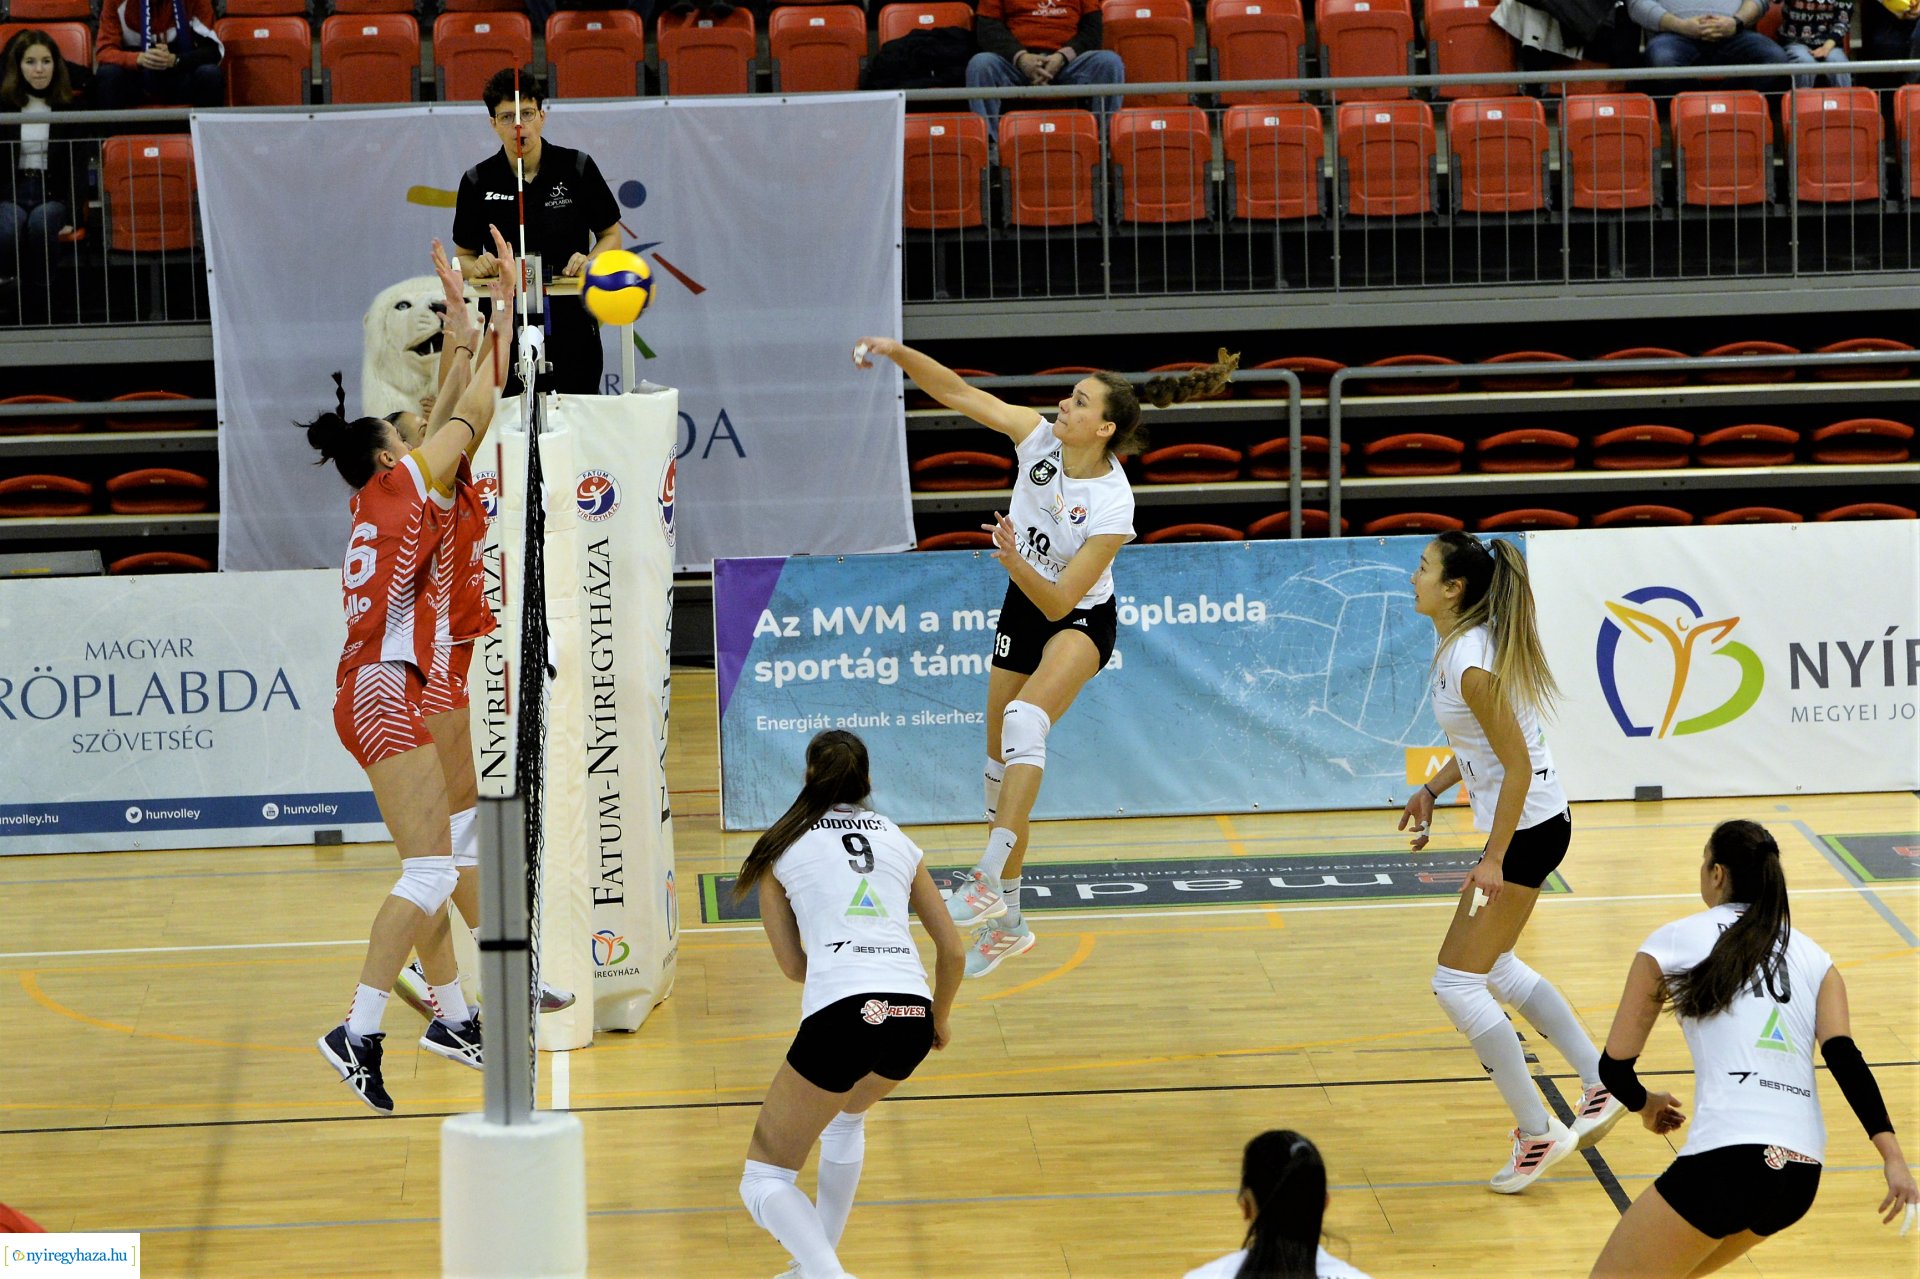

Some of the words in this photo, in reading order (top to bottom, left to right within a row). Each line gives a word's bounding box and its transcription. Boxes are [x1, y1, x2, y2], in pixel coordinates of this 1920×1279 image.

[484, 191, 515, 201] Zeus
[476, 471, 496, 480] FATU
[582, 471, 609, 480] FATUM
[343, 523, 378, 589] 6
[753, 609, 801, 639] Az
[812, 604, 906, 636] MVM
[919, 611, 940, 633] a
[952, 608, 1001, 632] ma
[1117, 593, 1267, 632] öplabda
[85, 638, 195, 662] MAGYAR
[754, 647, 899, 689] sportág
[756, 713, 831, 733] Energiát
[836, 711, 891, 730] adunk
[895, 715, 907, 727] a
[911, 709, 985, 728] sikerhez
[1791, 704, 1878, 723] MEGYEI
[1888, 702, 1918, 721] JO
[72, 725, 214, 754] SZÖVETSÉG
[145, 808, 201, 821] hunvolley
[283, 803, 339, 815] hunvolley
[841, 832, 876, 874] 9
[852, 945, 911, 955] BESTRONG
[594, 966, 641, 979] ÍREGYHÁZA
[888, 1005, 926, 1018] REVESZ
[1759, 1079, 1811, 1098] BESTRONG
